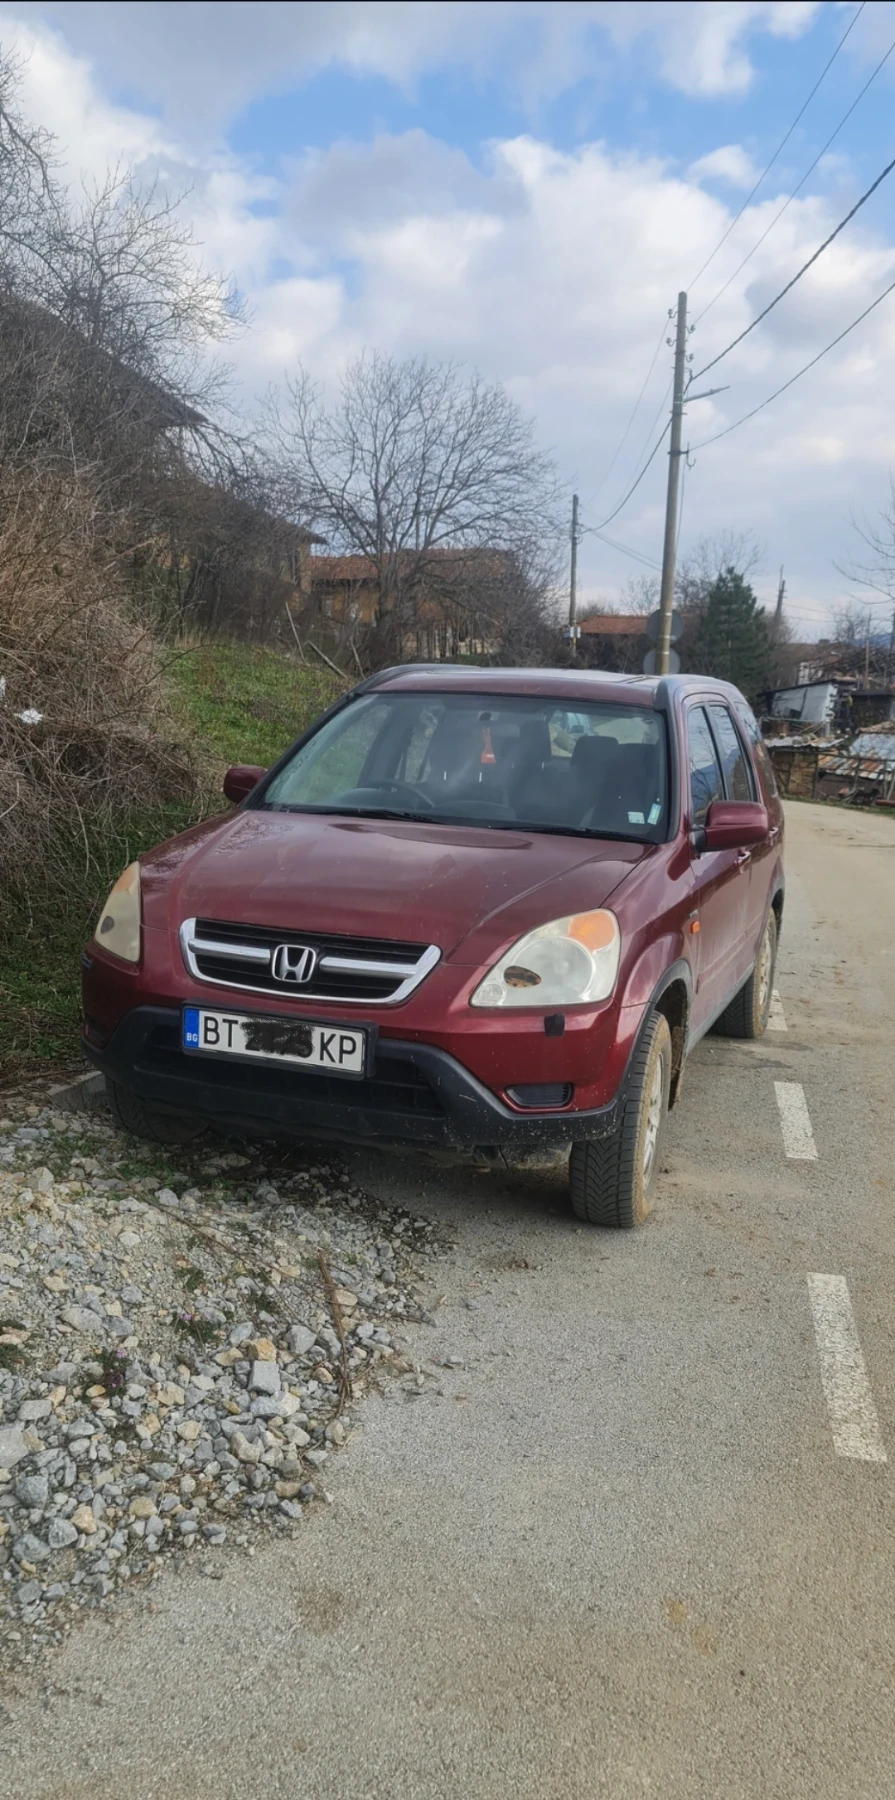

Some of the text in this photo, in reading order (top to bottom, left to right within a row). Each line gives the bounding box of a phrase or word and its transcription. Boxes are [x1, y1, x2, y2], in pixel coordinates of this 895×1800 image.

[186, 1032, 198, 1042] BG
[204, 1016, 239, 1048] BT
[320, 1032, 357, 1064] KP
